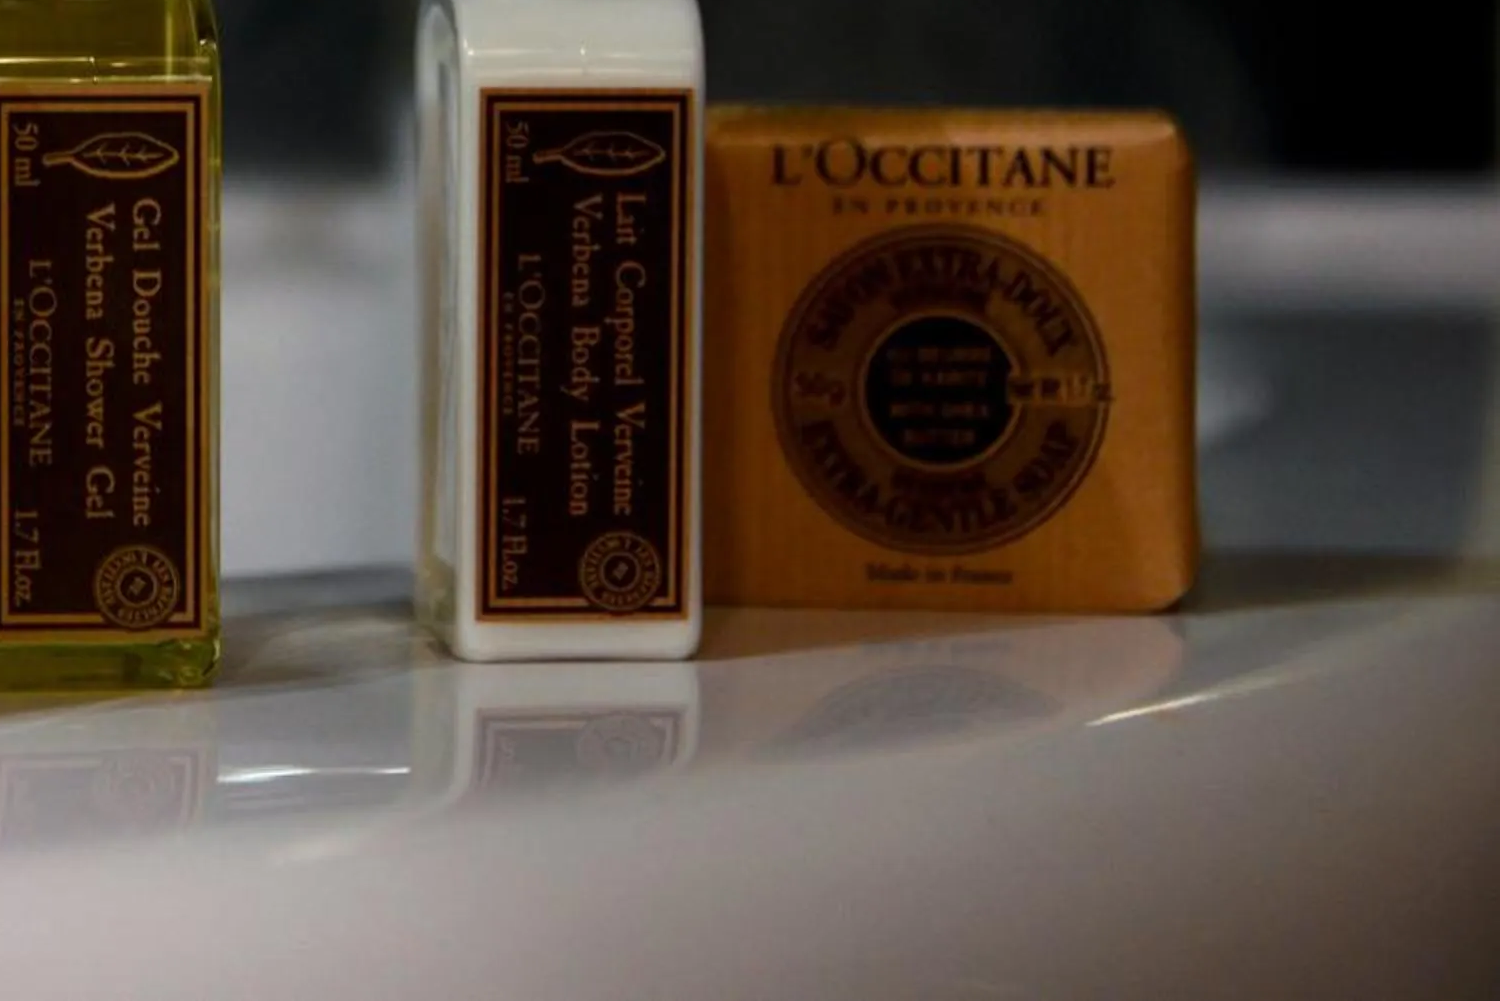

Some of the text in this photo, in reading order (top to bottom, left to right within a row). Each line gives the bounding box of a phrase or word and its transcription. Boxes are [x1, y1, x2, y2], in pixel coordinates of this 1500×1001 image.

[13, 122, 41, 187] 50 ml
[504, 121, 530, 183] 50 ml
[771, 138, 1116, 189] L'OCCITANE
[885, 197, 1043, 217] PROVENCE
[615, 192, 647, 245] Lait
[29, 259, 58, 468] L'OCCITANE
[85, 203, 117, 519] Verbena Shower Gel
[132, 198, 163, 528] Gel Douche Verveine
[517, 254, 546, 455] L'OCCITANE
[560, 193, 604, 516] Verbena Body Lotion
[604, 260, 647, 386] Corporel
[614, 402, 647, 517] Verveine
[13, 510, 39, 544] 1.7
